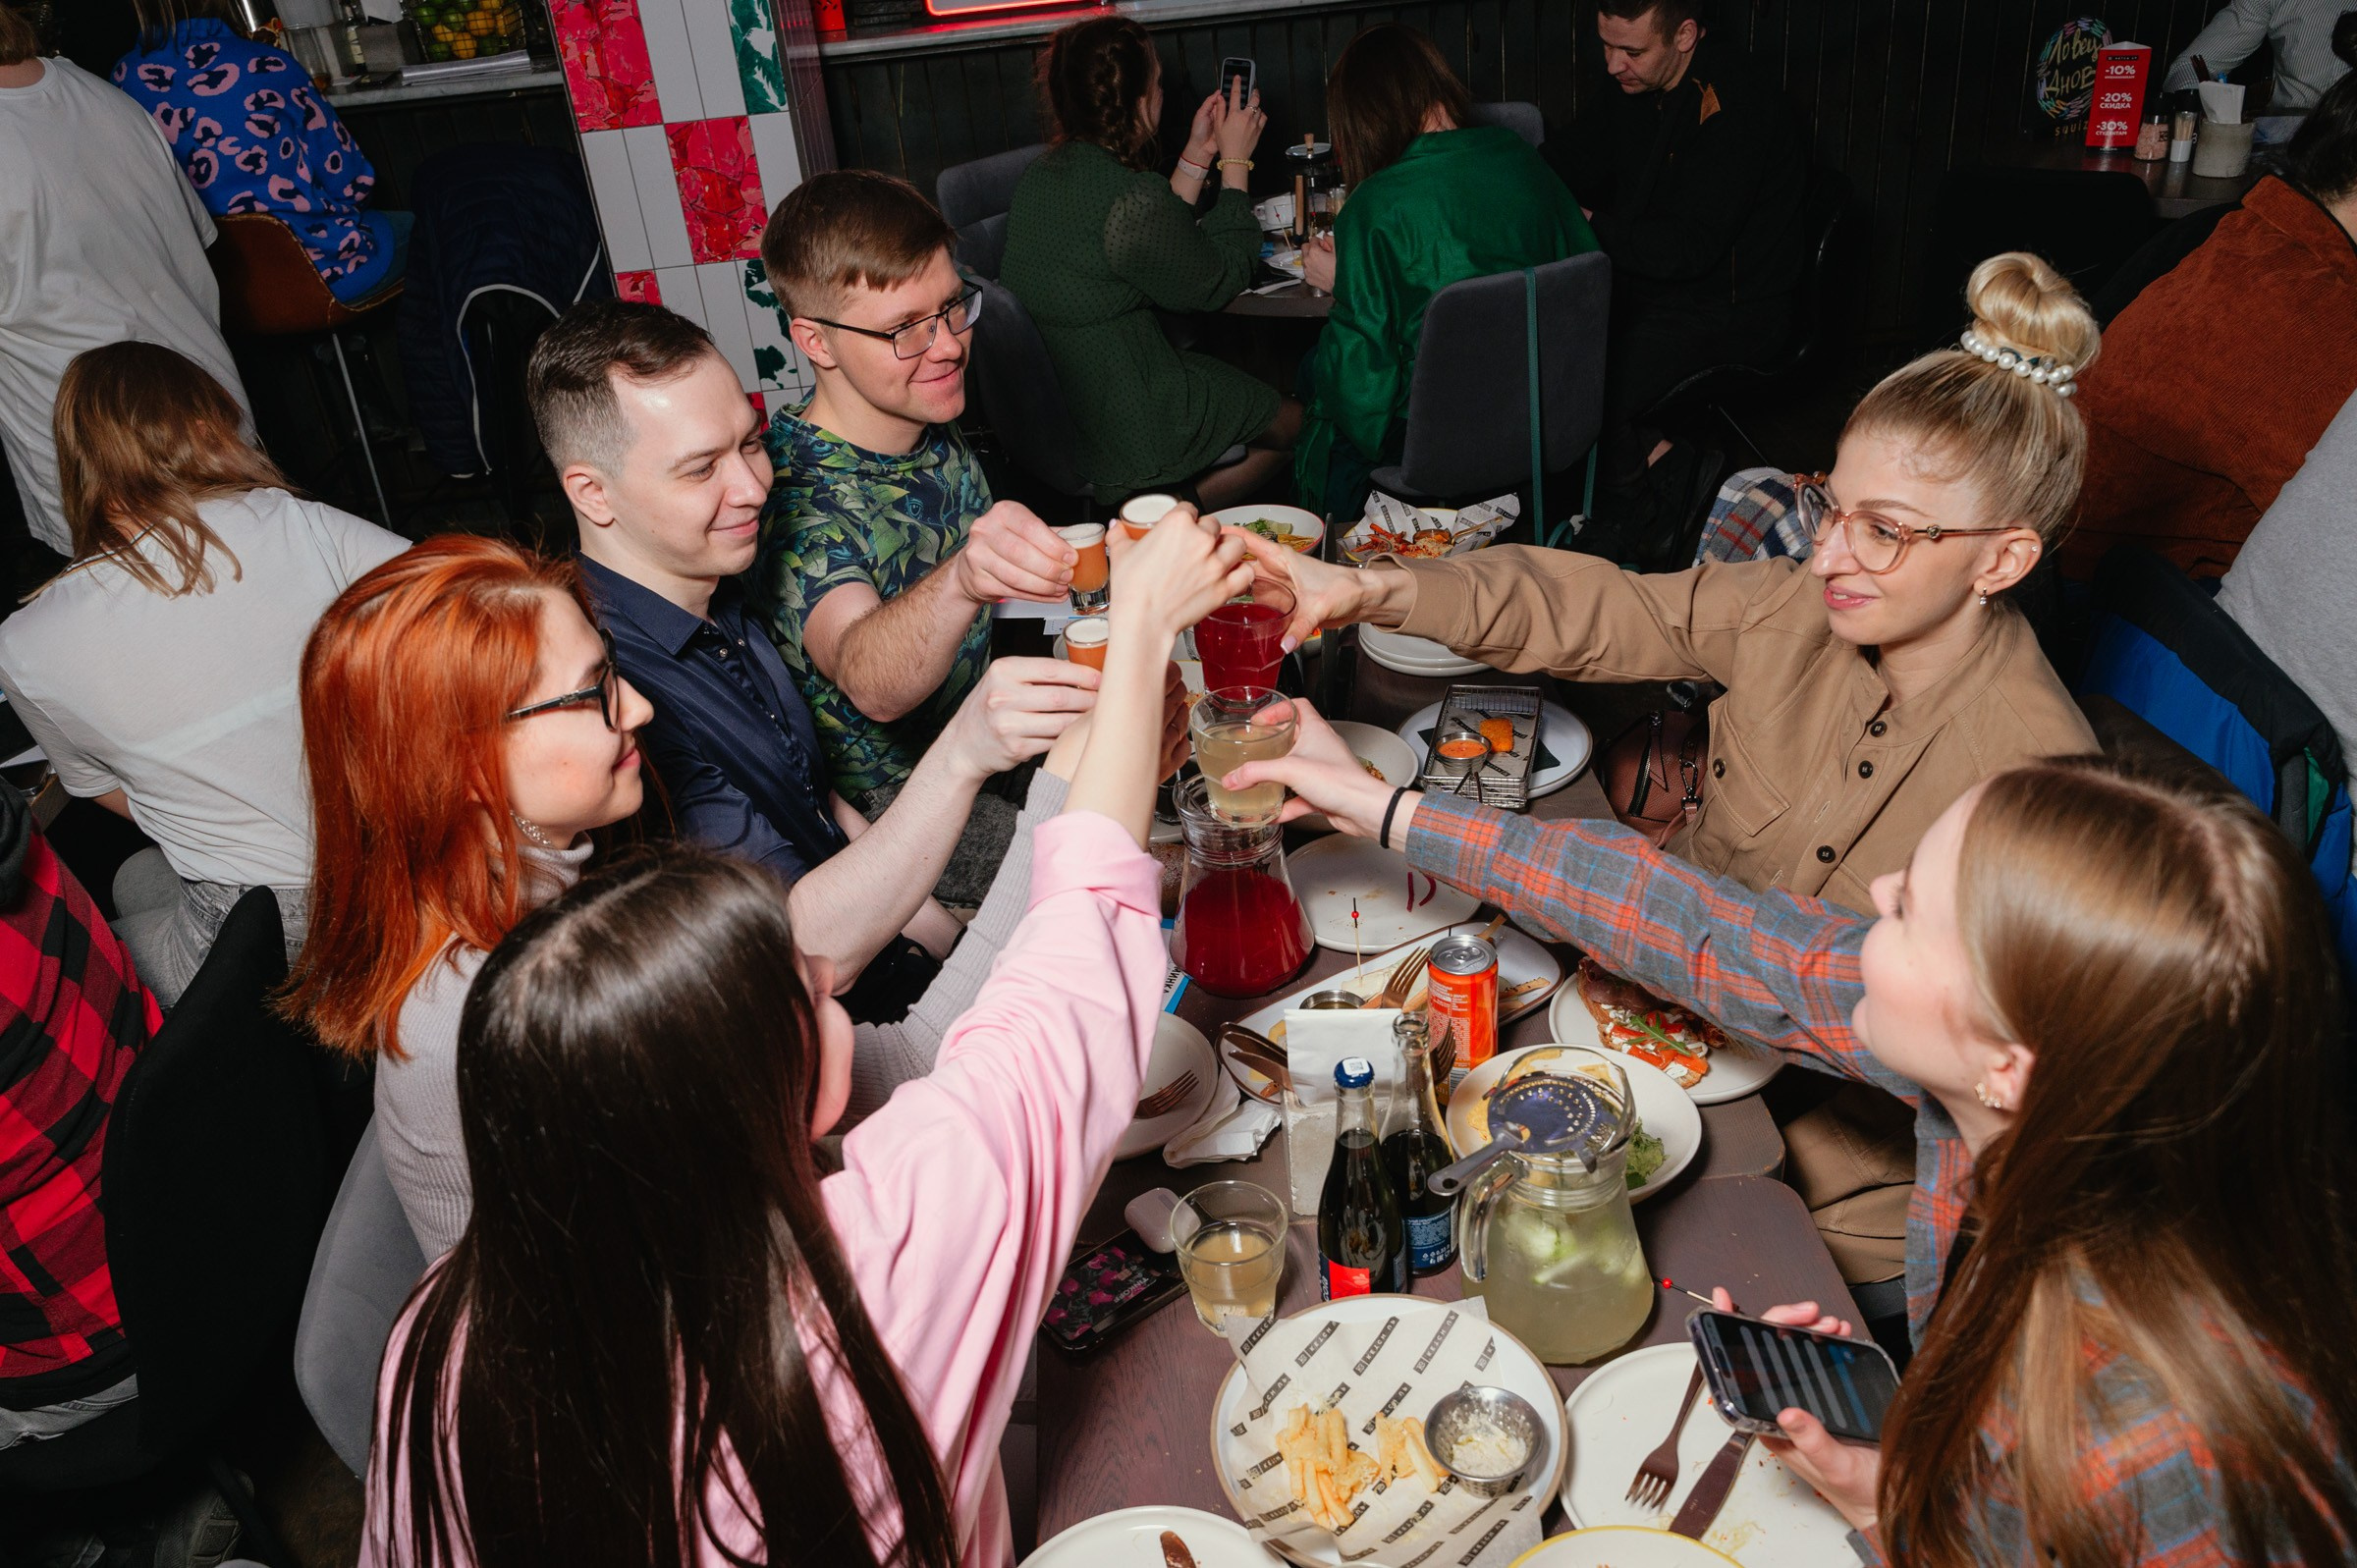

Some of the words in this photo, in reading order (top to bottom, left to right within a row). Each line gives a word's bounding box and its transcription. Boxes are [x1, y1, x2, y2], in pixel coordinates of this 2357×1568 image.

[2105, 65, 2136, 75] -10%
[2101, 92, 2132, 102] -20%
[2096, 121, 2128, 131] -30%
